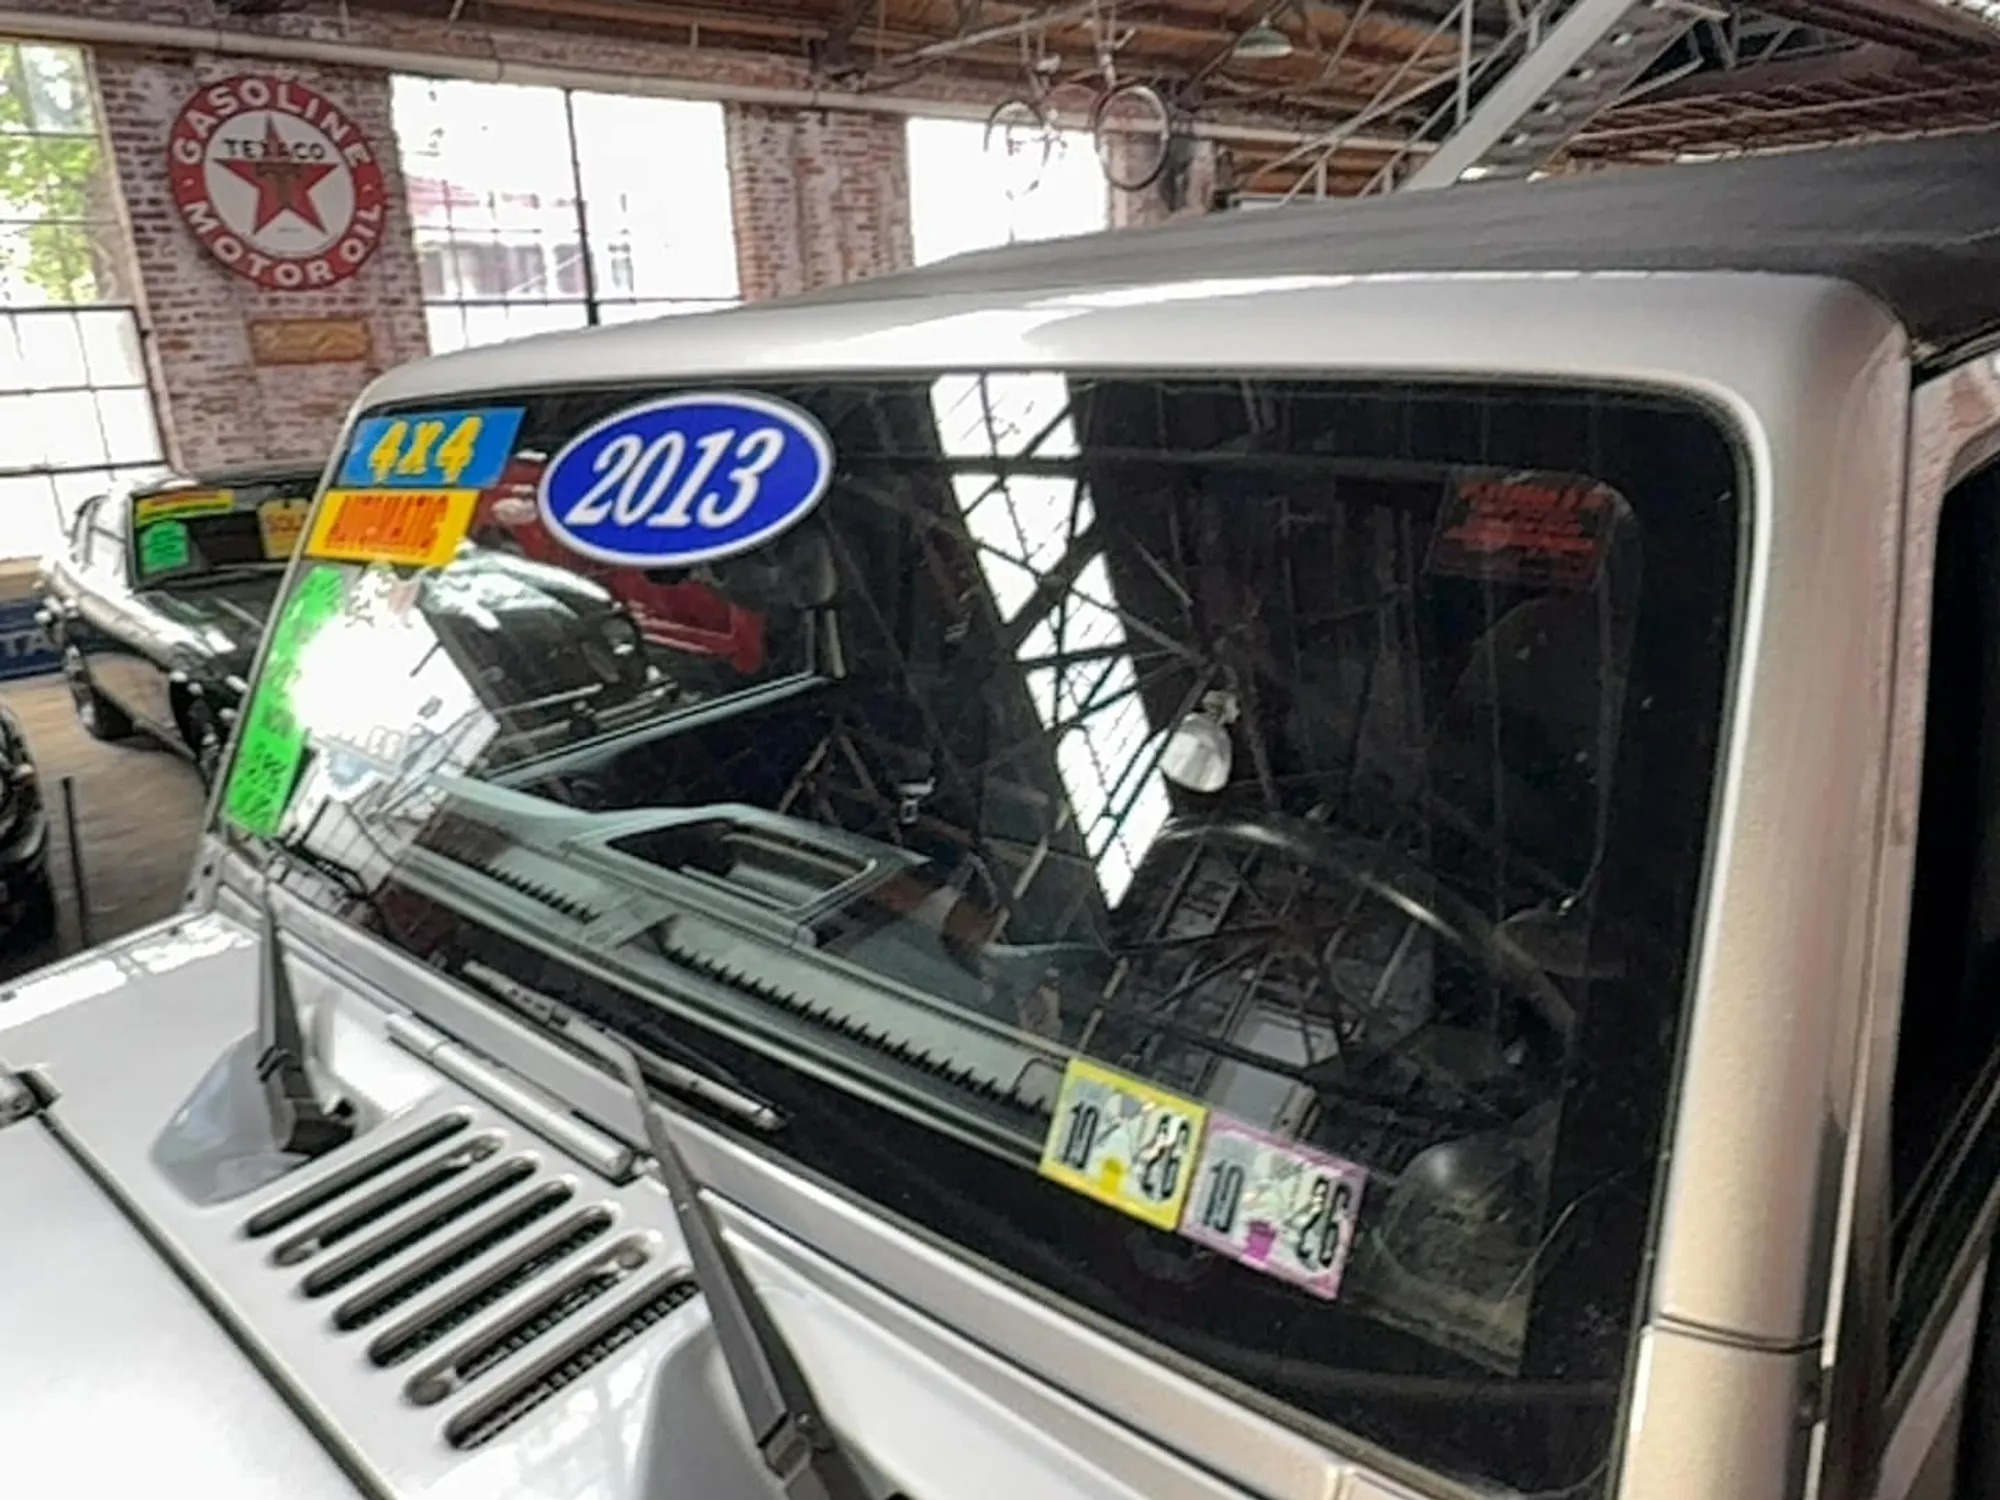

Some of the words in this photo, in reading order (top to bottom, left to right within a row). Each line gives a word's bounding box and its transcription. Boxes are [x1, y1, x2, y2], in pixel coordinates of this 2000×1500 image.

[173, 78, 371, 168] GASOLINE
[184, 200, 335, 284] MOTOR
[339, 204, 381, 263] OIL
[563, 427, 785, 529] 2013
[1063, 1100, 1099, 1170] 10
[1203, 1158, 1244, 1234] 10
[1296, 1176, 1351, 1267] 26
